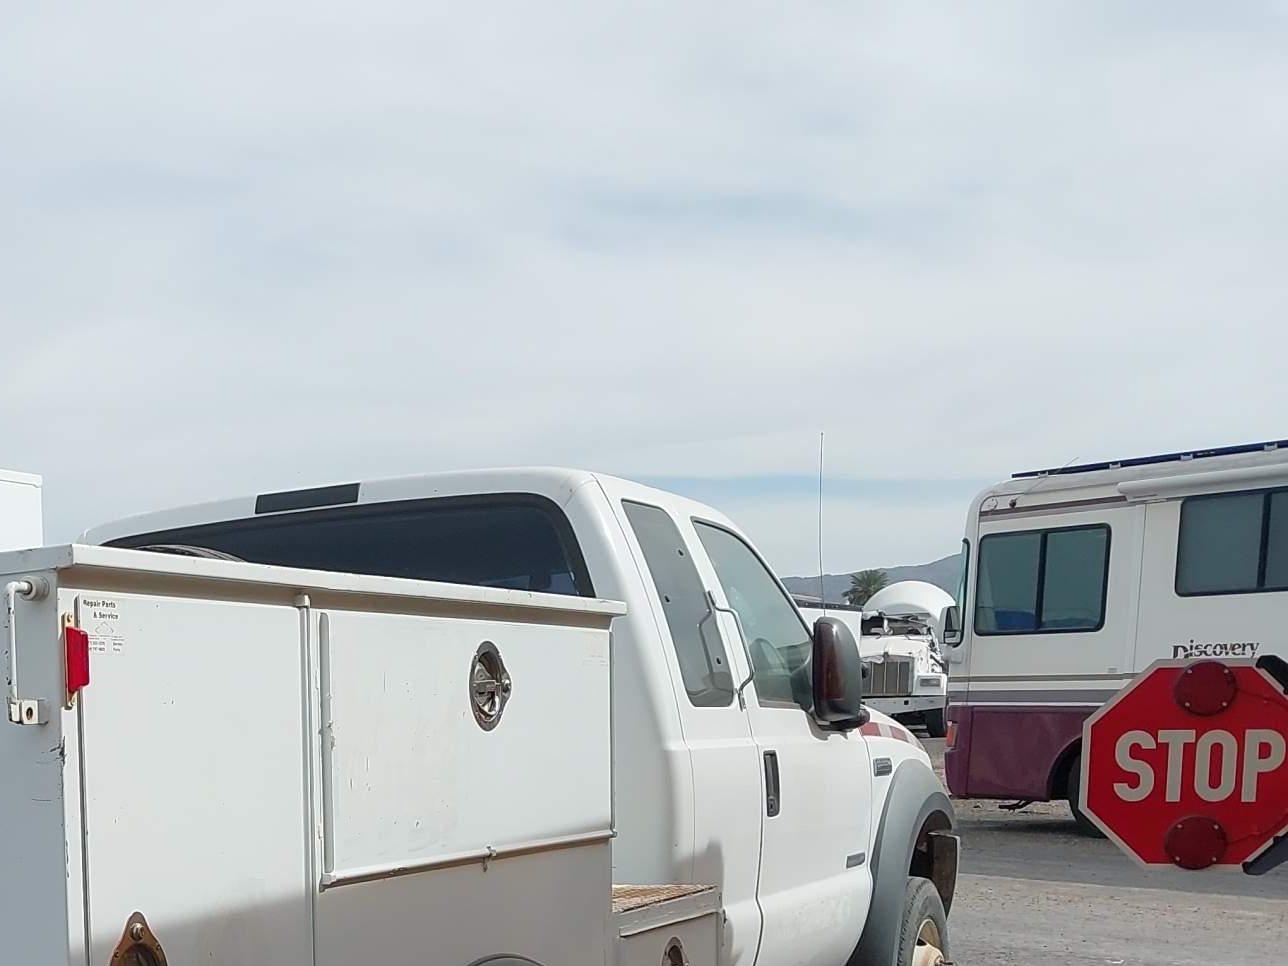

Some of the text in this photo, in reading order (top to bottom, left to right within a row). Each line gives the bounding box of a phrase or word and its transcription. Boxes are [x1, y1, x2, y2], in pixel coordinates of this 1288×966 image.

[83, 599, 116, 609] Repair Parts
[99, 611, 119, 620] Service
[1172, 639, 1260, 658] Discovery
[1113, 728, 1286, 803] STOP
